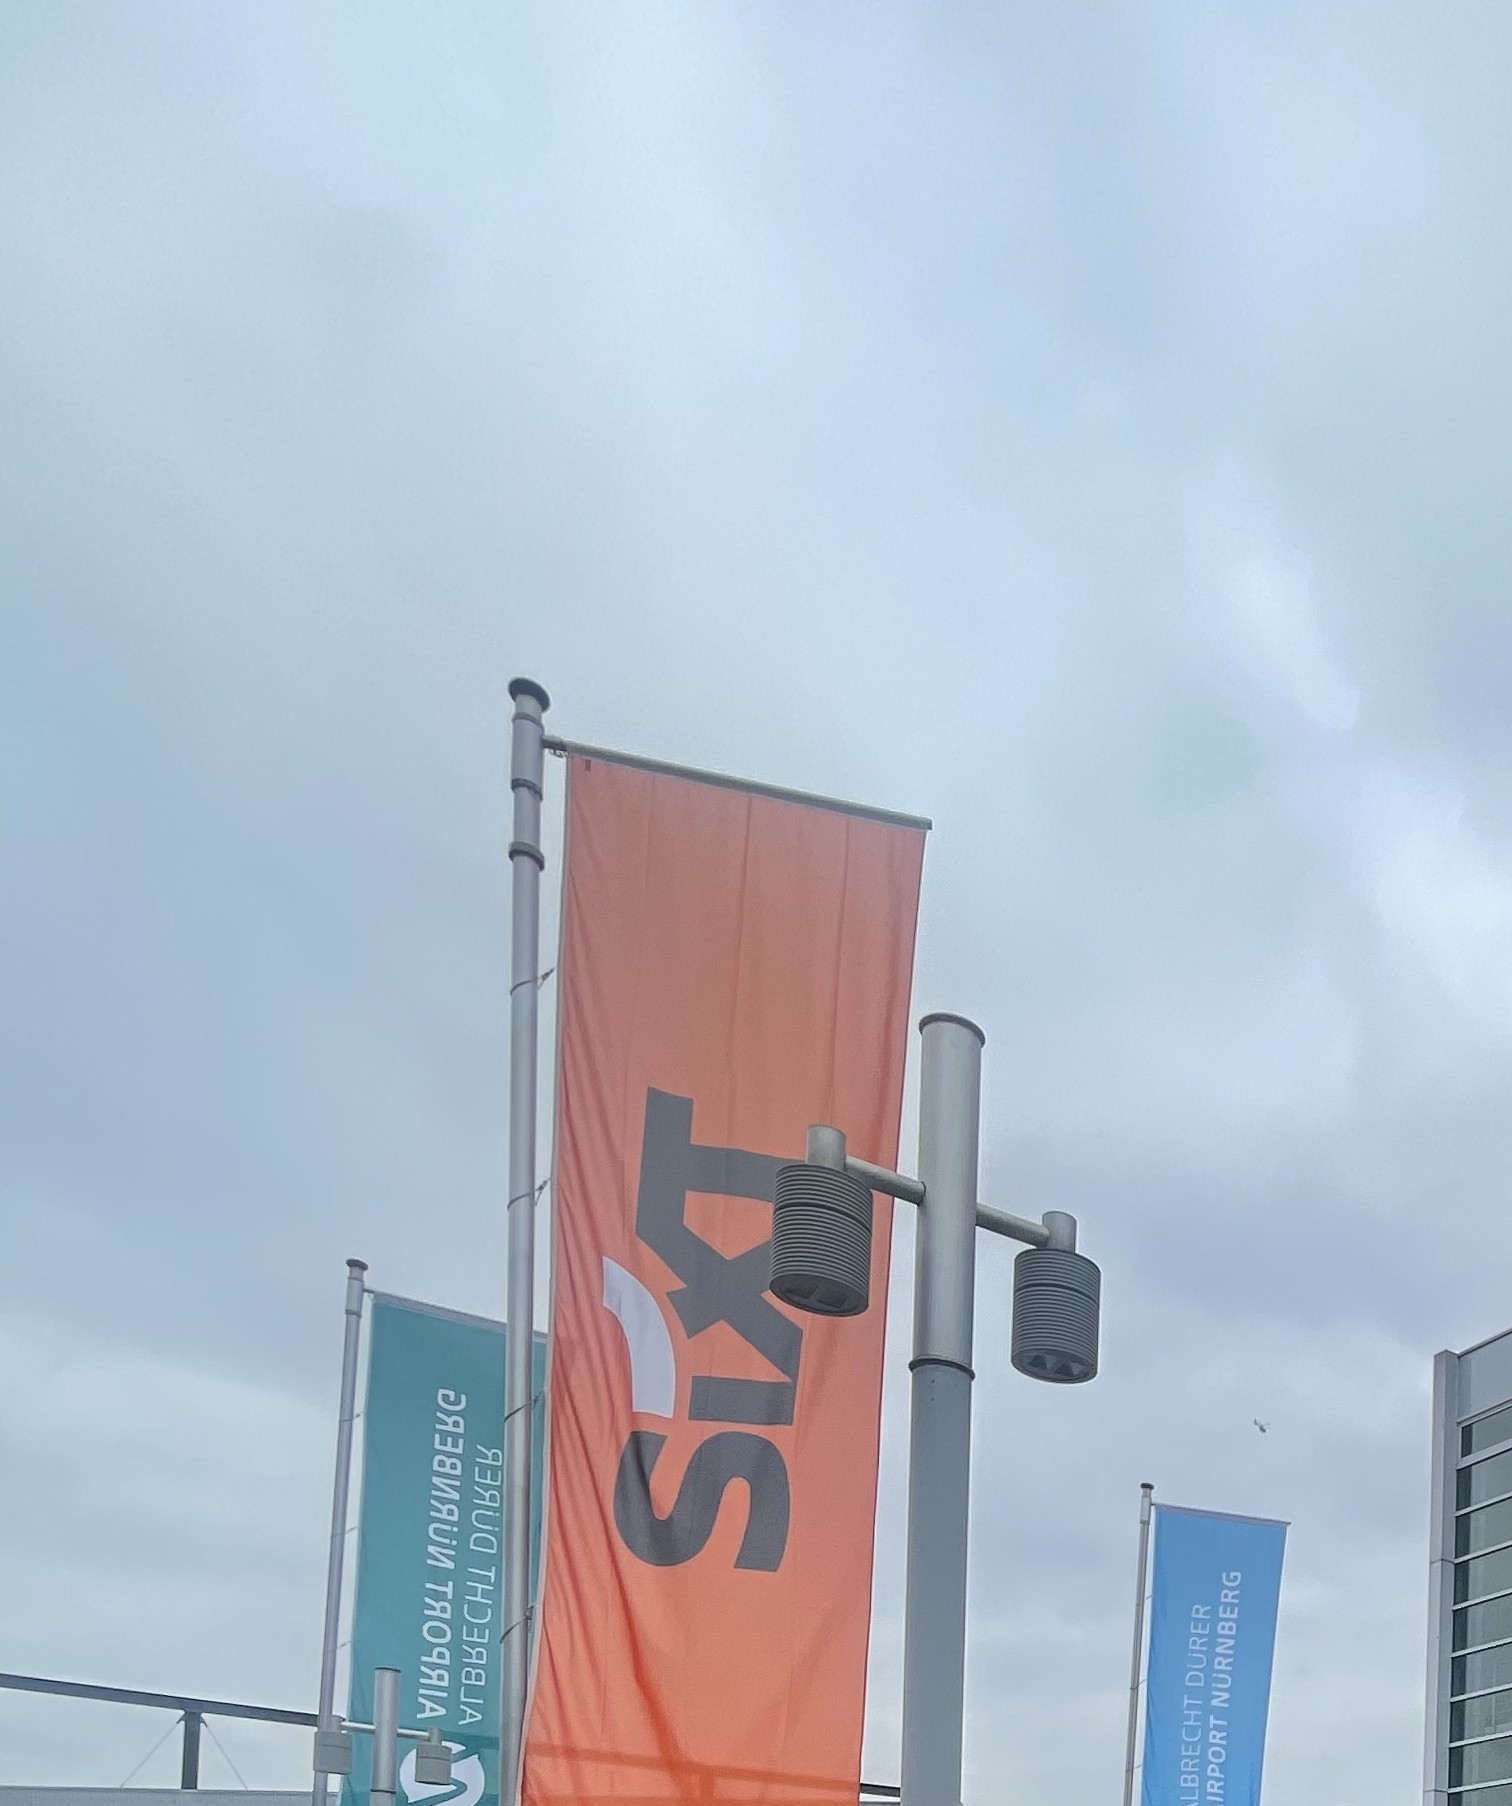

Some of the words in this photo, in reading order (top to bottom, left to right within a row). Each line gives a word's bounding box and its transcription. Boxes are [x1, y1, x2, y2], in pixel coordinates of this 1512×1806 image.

[603, 1086, 804, 1572] SIXT
[1185, 1604, 1212, 1687] DÜRER
[1210, 1571, 1242, 1708] NÜRNBERG
